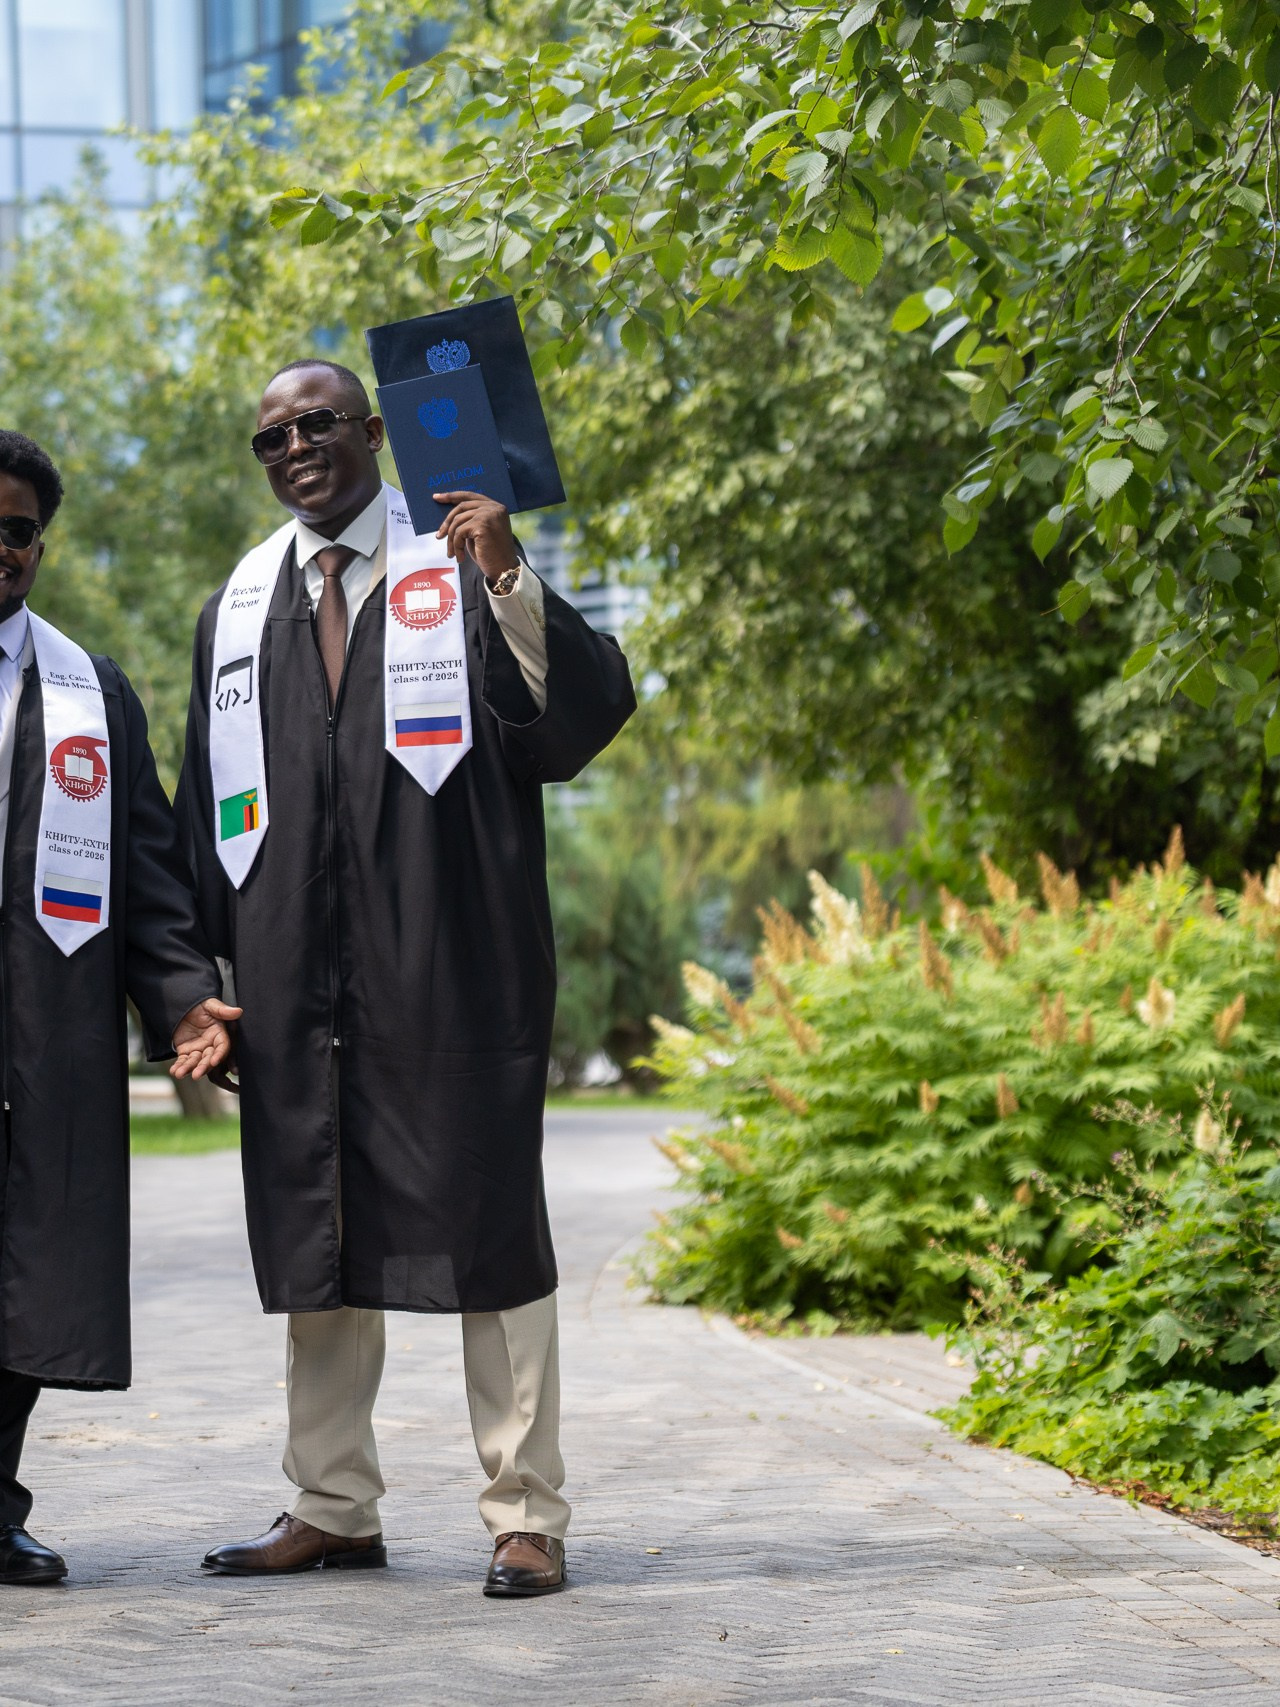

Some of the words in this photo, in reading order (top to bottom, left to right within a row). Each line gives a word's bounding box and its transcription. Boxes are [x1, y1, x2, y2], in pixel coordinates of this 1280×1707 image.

[428, 464, 484, 488] ДИПЛОМ
[391, 509, 408, 518] Eng.
[230, 584, 262, 597] Всегда
[413, 581, 431, 589] 1890
[230, 599, 260, 610] Богом
[406, 611, 442, 621] КНИТУ
[388, 659, 463, 673] КНИТУ-КХТИ
[41, 677, 70, 687] Chanda
[49, 671, 67, 680] Eng.
[68, 674, 90, 683] Caleb
[393, 675, 420, 684] class
[422, 673, 434, 682] of
[435, 672, 458, 681] 2026
[72, 746, 87, 755] 1890
[65, 780, 95, 794] КНИТУ
[45, 830, 110, 850] КНИТУ-КХТИ
[48, 843, 71, 855] class
[73, 849, 84, 857] of
[84, 850, 105, 861] 2026
